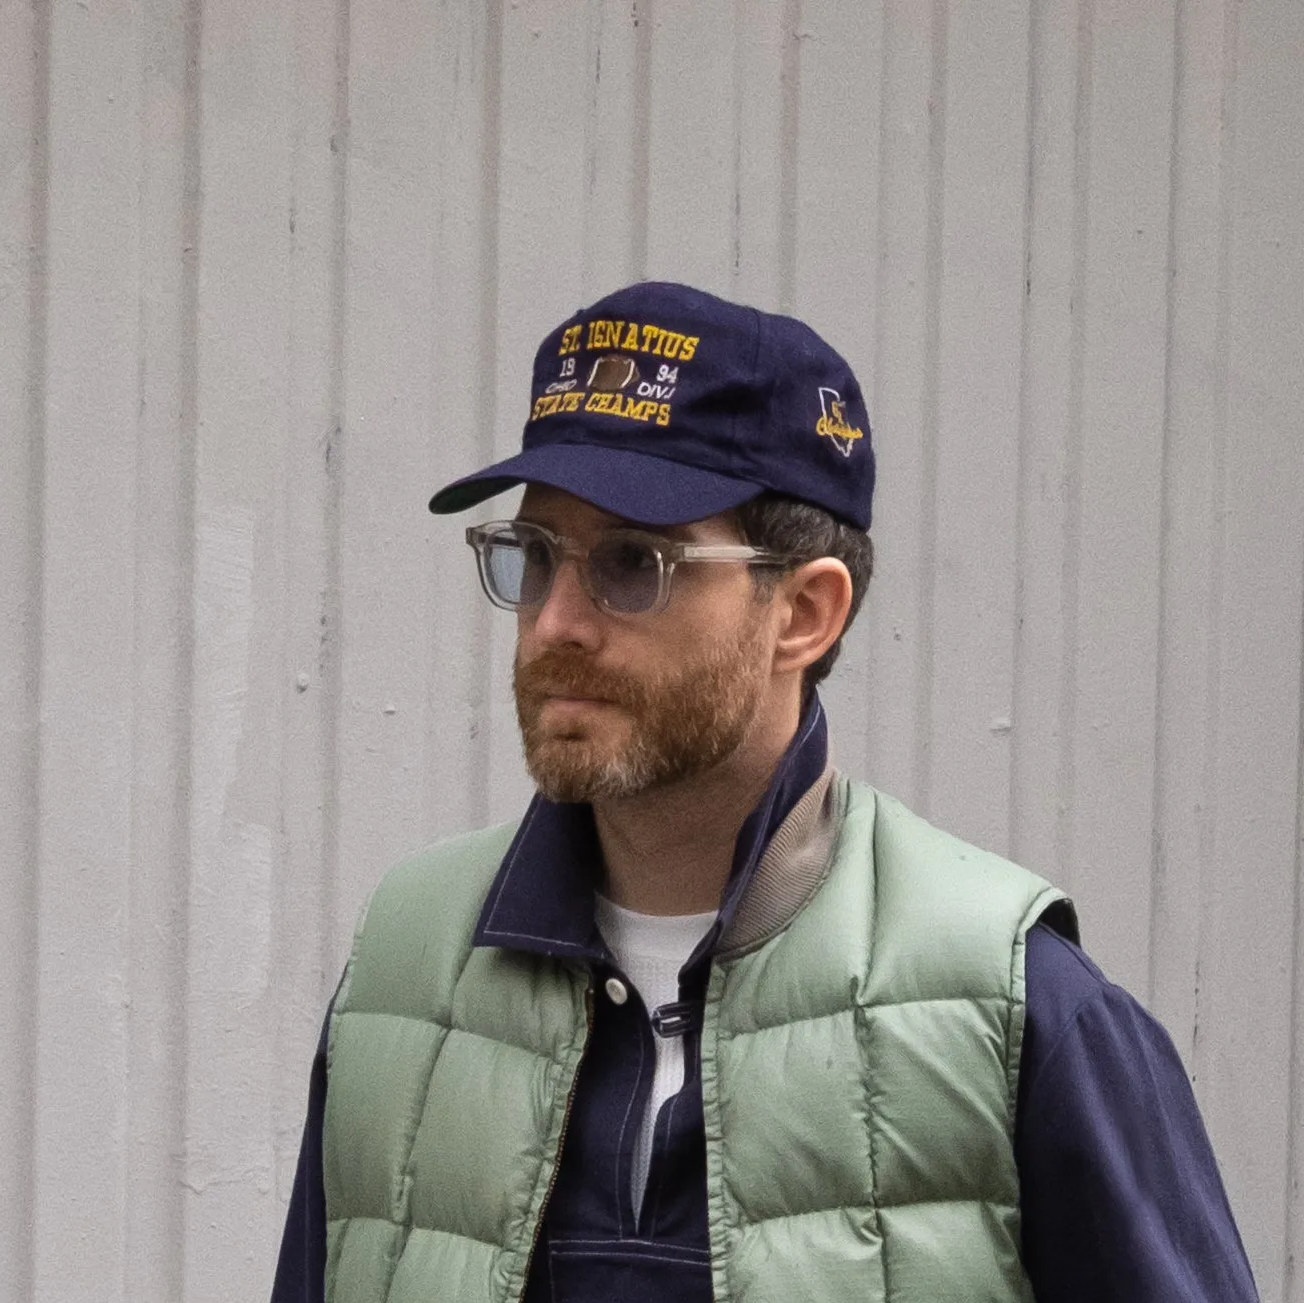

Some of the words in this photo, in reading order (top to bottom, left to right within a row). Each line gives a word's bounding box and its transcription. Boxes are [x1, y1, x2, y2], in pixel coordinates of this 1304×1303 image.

[558, 324, 582, 356] ST.
[586, 319, 700, 361] IGNATIUS
[559, 357, 577, 378] 19
[656, 364, 679, 384] 94
[531, 392, 586, 421] STATE
[585, 392, 672, 427] CHAMPS
